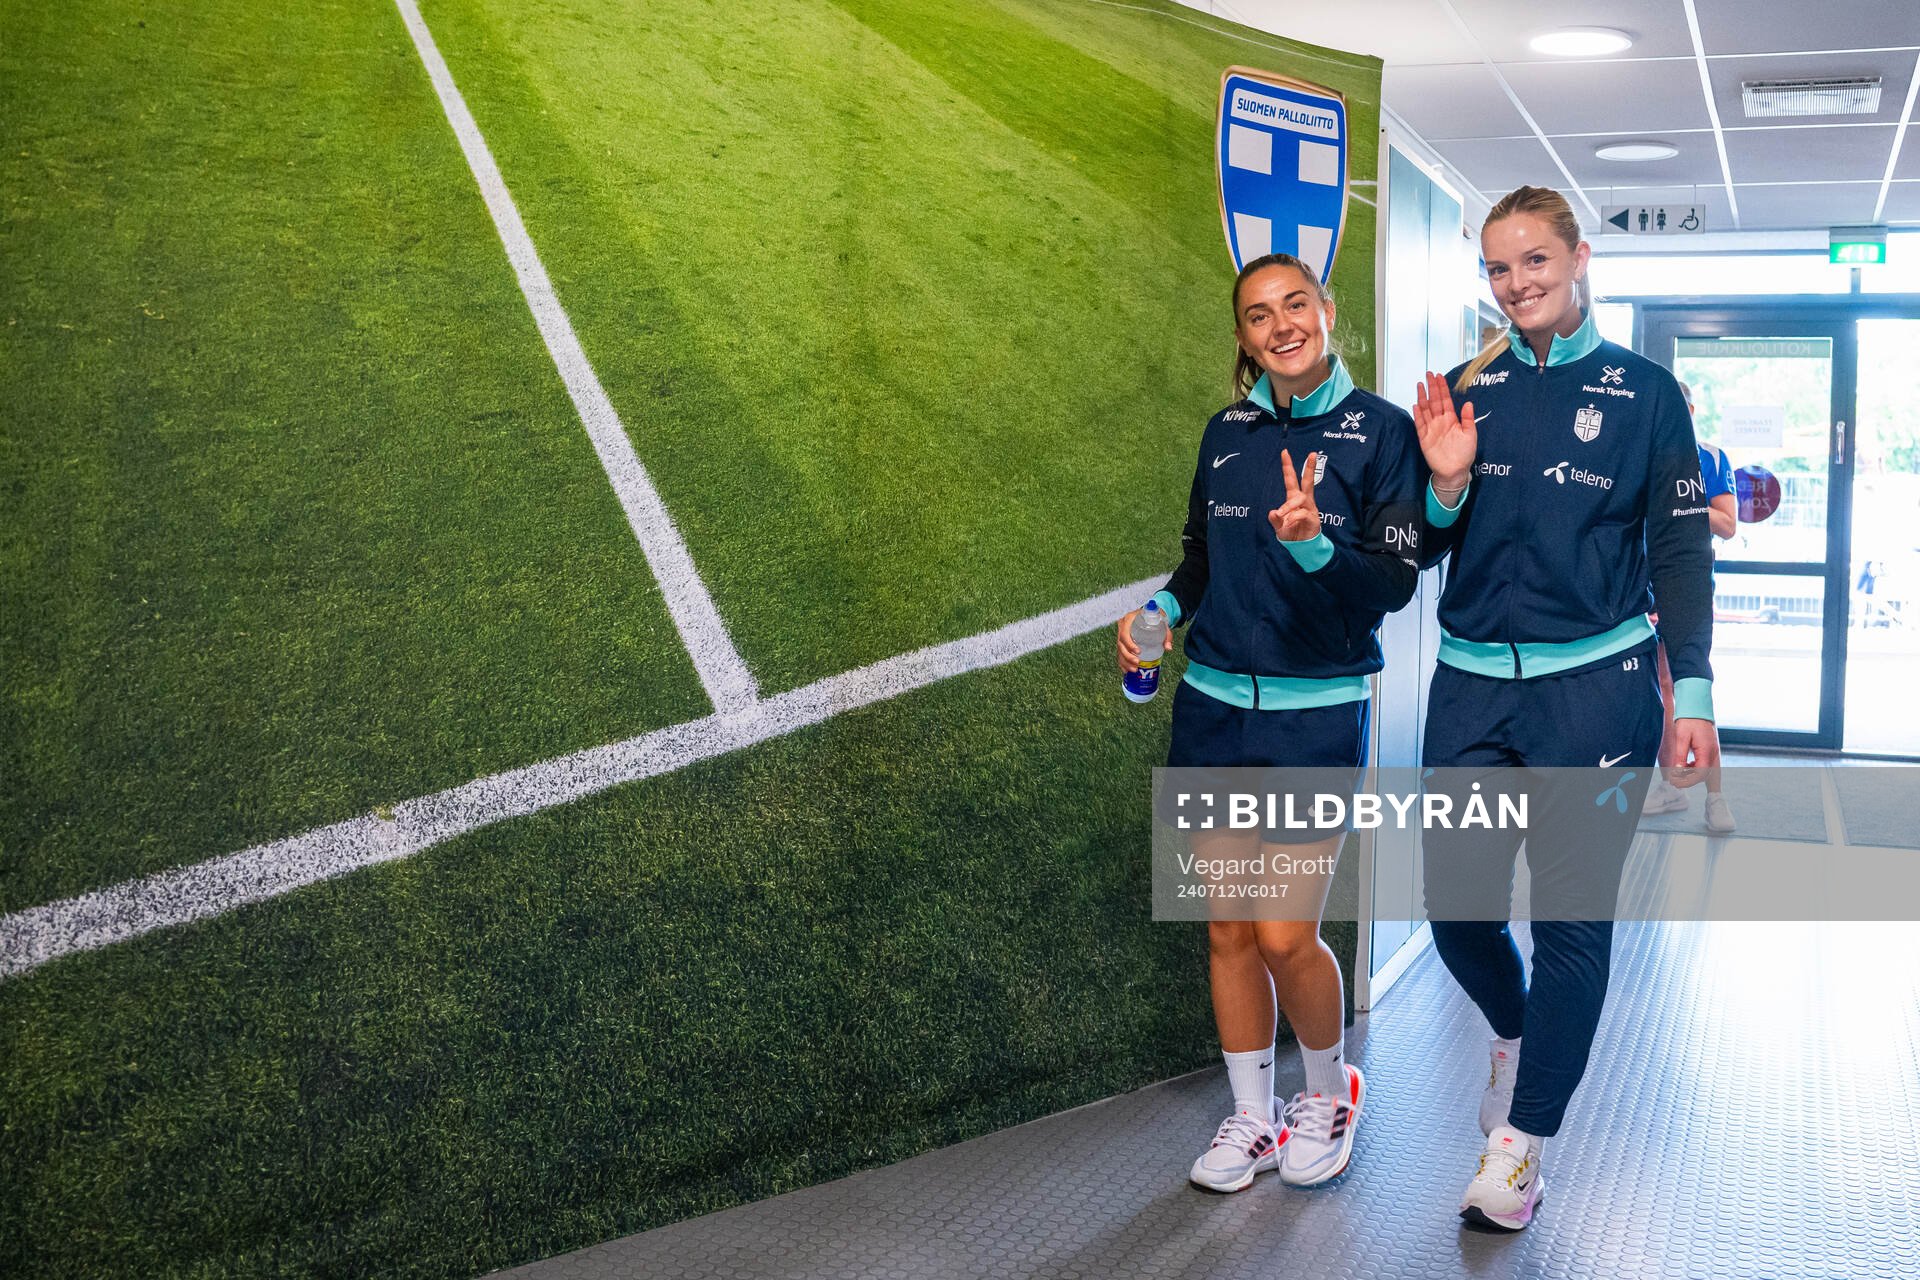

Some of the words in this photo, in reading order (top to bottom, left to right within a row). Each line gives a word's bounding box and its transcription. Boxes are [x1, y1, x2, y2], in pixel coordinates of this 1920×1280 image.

[1237, 98, 1277, 118] SUOMEN
[1278, 108, 1334, 130] PALLOLIITTO
[1583, 385, 1605, 394] Norsk
[1606, 386, 1635, 399] Tipping
[1323, 431, 1343, 439] Norsk
[1570, 467, 1615, 490] teleno
[1676, 470, 1705, 501] DN
[1214, 503, 1250, 518] telenor
[1385, 523, 1418, 551] DNB
